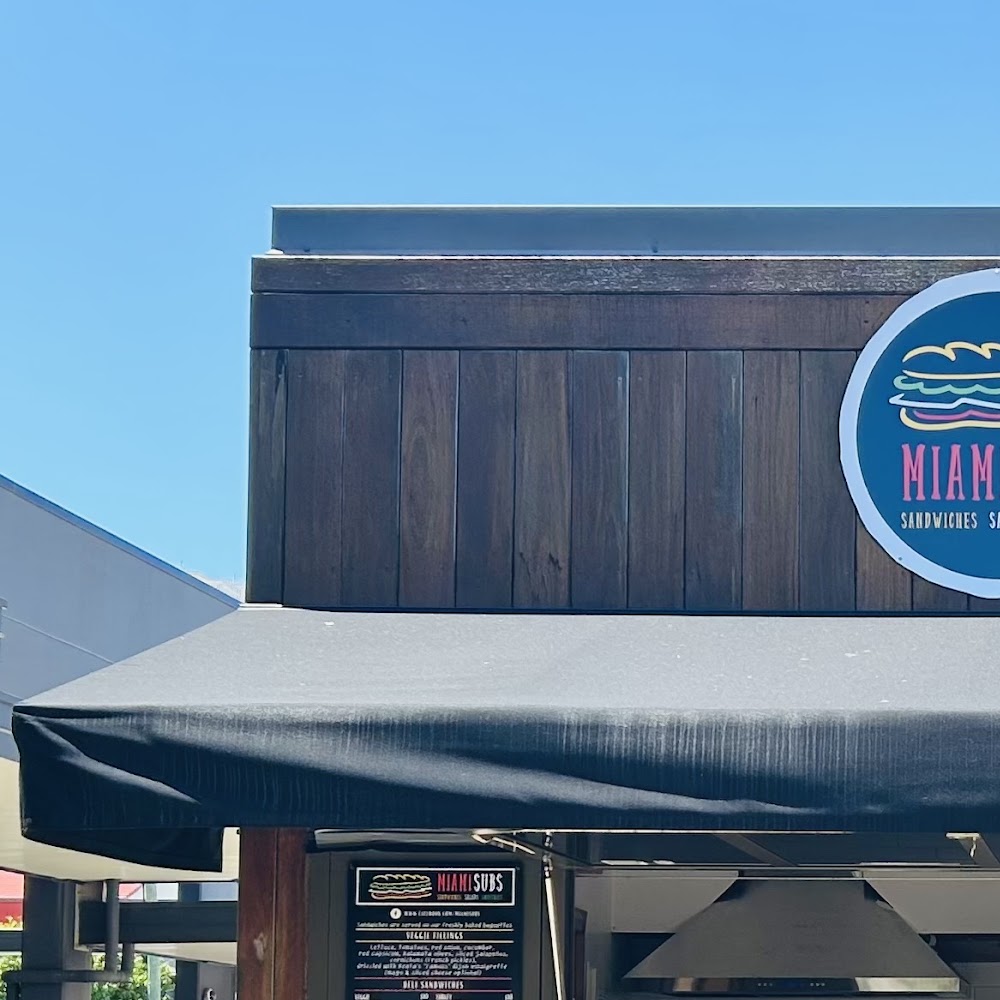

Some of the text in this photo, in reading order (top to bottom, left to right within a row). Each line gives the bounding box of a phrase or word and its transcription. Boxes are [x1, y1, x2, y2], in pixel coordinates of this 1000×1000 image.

[901, 511, 978, 530] SANDWICHES
[406, 932, 464, 940] VEGGIE FILLINGS
[420, 981, 464, 989] SANDWICHES
